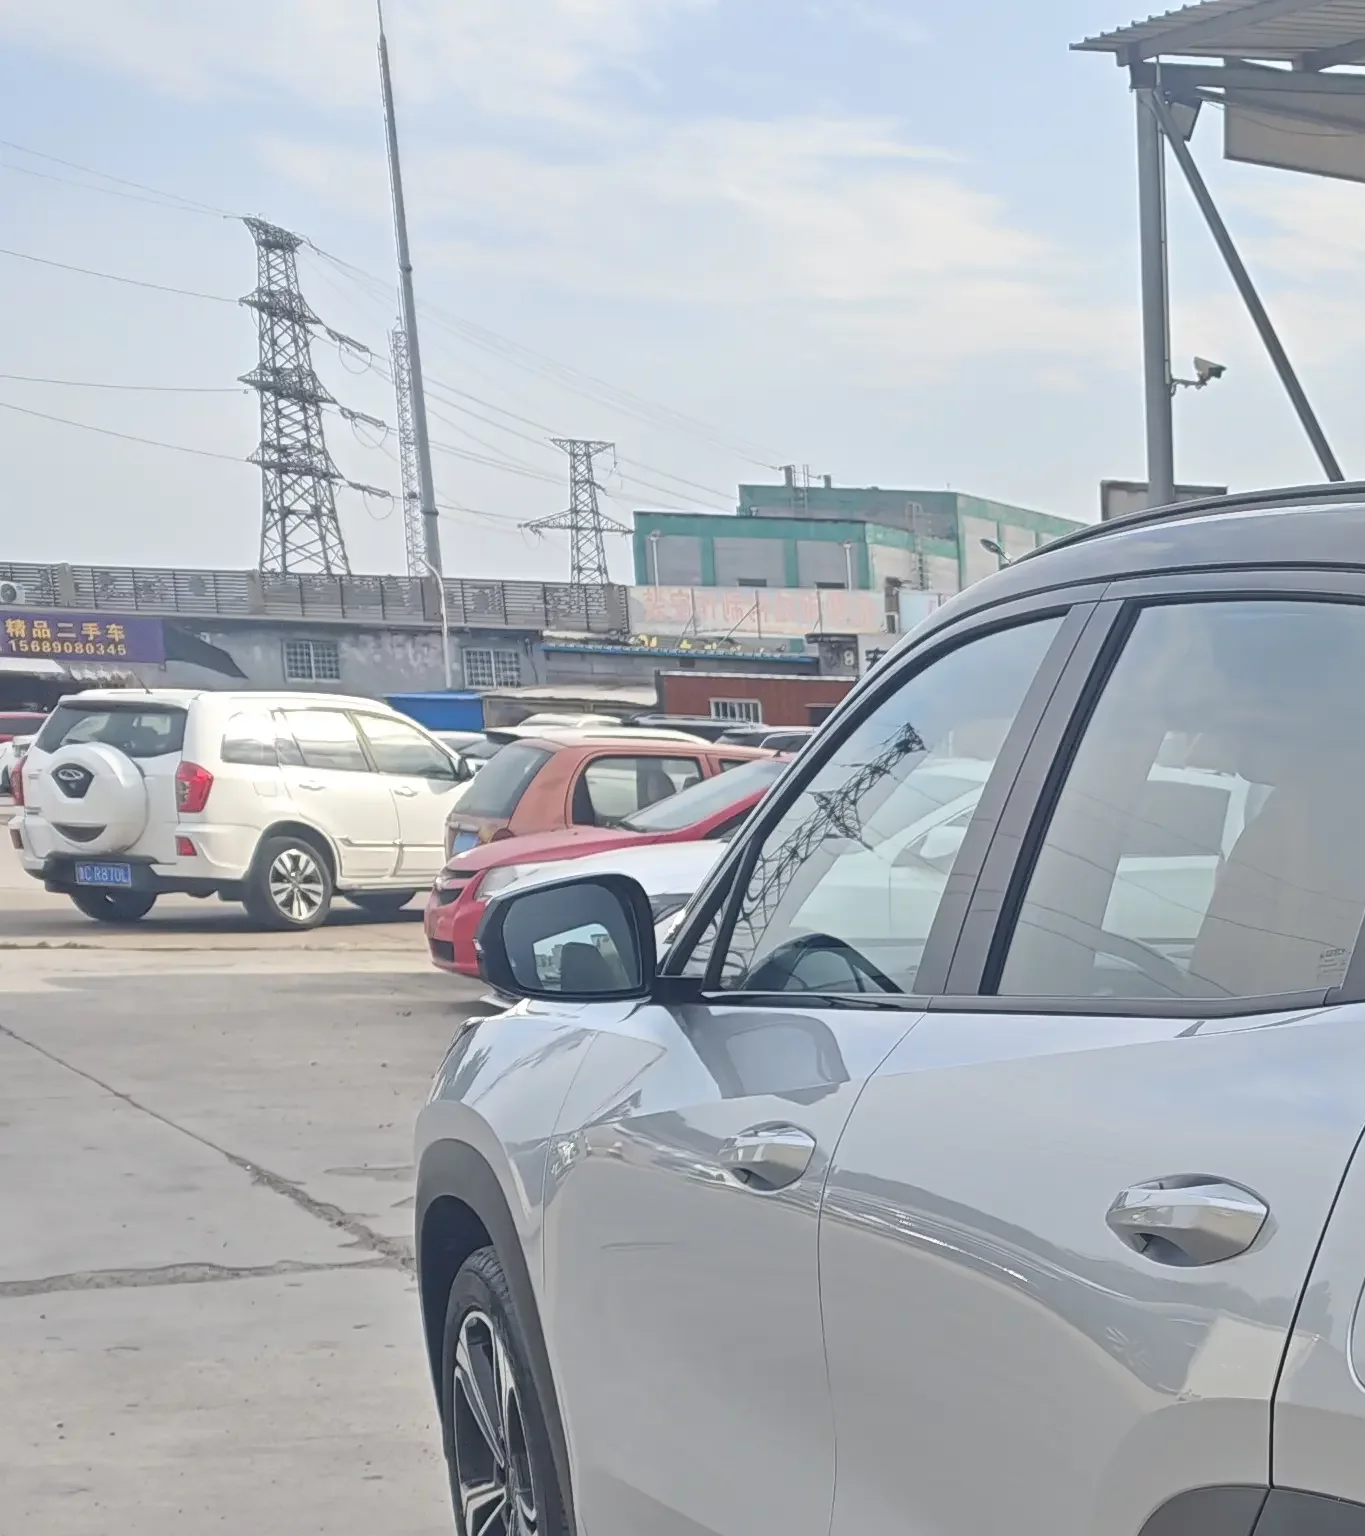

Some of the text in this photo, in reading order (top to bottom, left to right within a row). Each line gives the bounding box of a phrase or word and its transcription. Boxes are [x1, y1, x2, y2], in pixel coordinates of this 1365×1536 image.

[5, 618, 126, 642] 精品二手车
[8, 639, 127, 656] 15689080345
